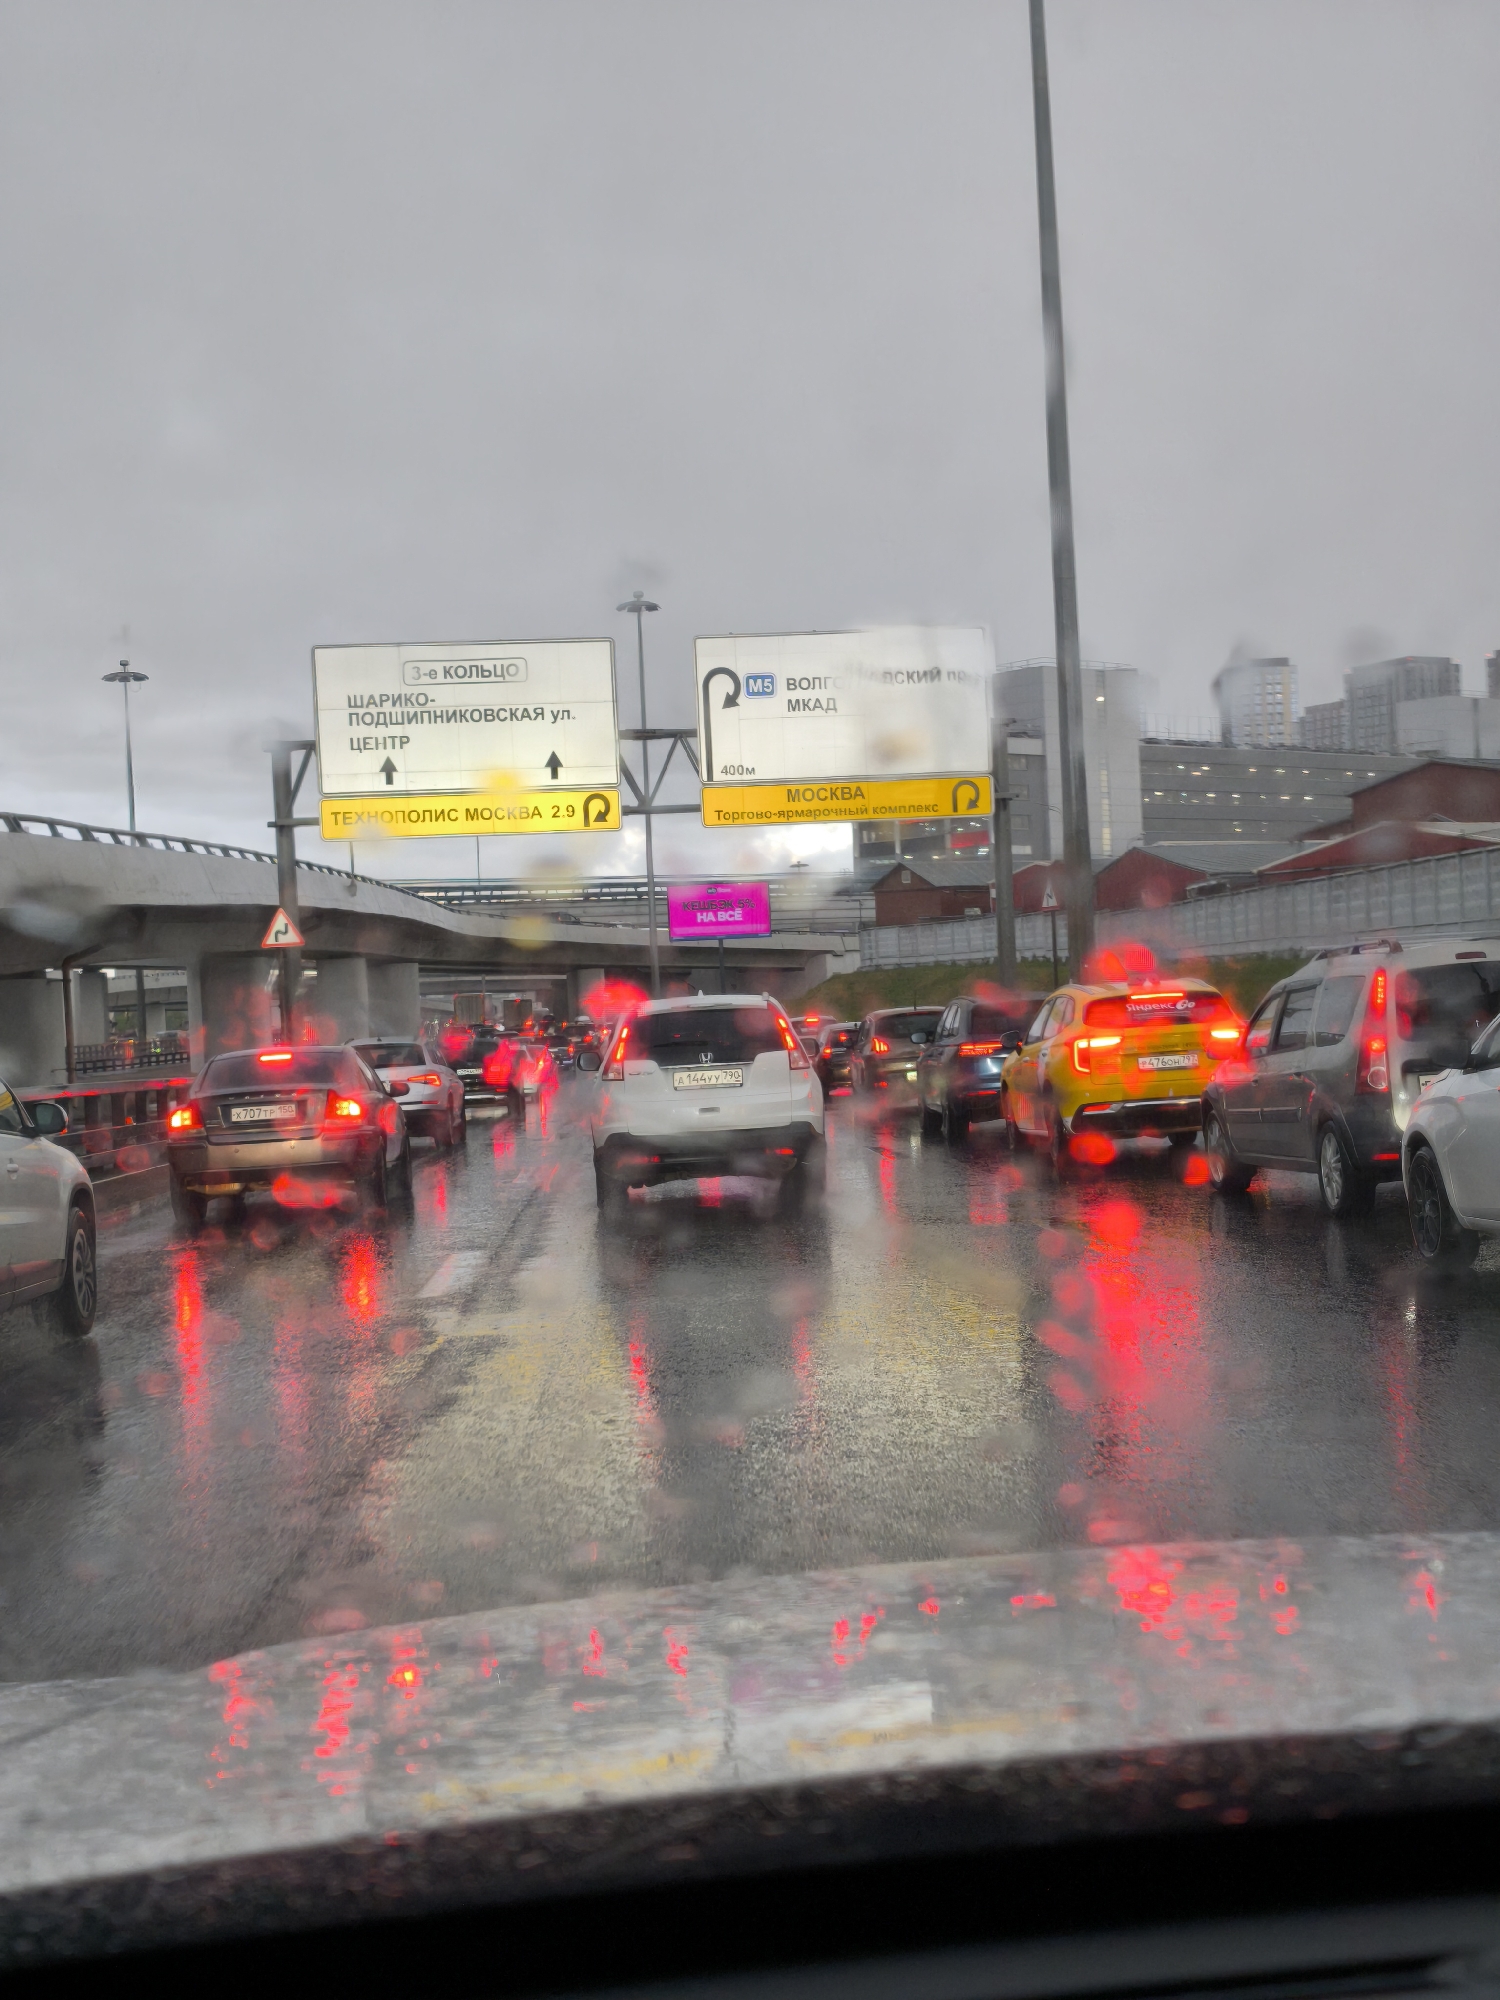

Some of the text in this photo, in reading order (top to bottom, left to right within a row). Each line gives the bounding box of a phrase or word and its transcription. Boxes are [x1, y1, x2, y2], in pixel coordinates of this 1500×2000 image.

[443, 663, 519, 681] КОЛЬЦО
[749, 678, 773, 694] М5
[347, 692, 436, 709] ШАРИКО-
[787, 697, 838, 713] МКАД
[348, 707, 577, 728] ПОДШИПНИКОВСКАЯ ул.
[350, 735, 411, 753] ЦЕНТР
[787, 786, 866, 803] МОСКВА
[330, 804, 576, 826] ТЕХНОПОЛИС МОСКВА 2.9
[872, 804, 939, 816] комплекс
[696, 908, 743, 923] НА ВСЁ
[1125, 1002, 1175, 1011] Яндекс
